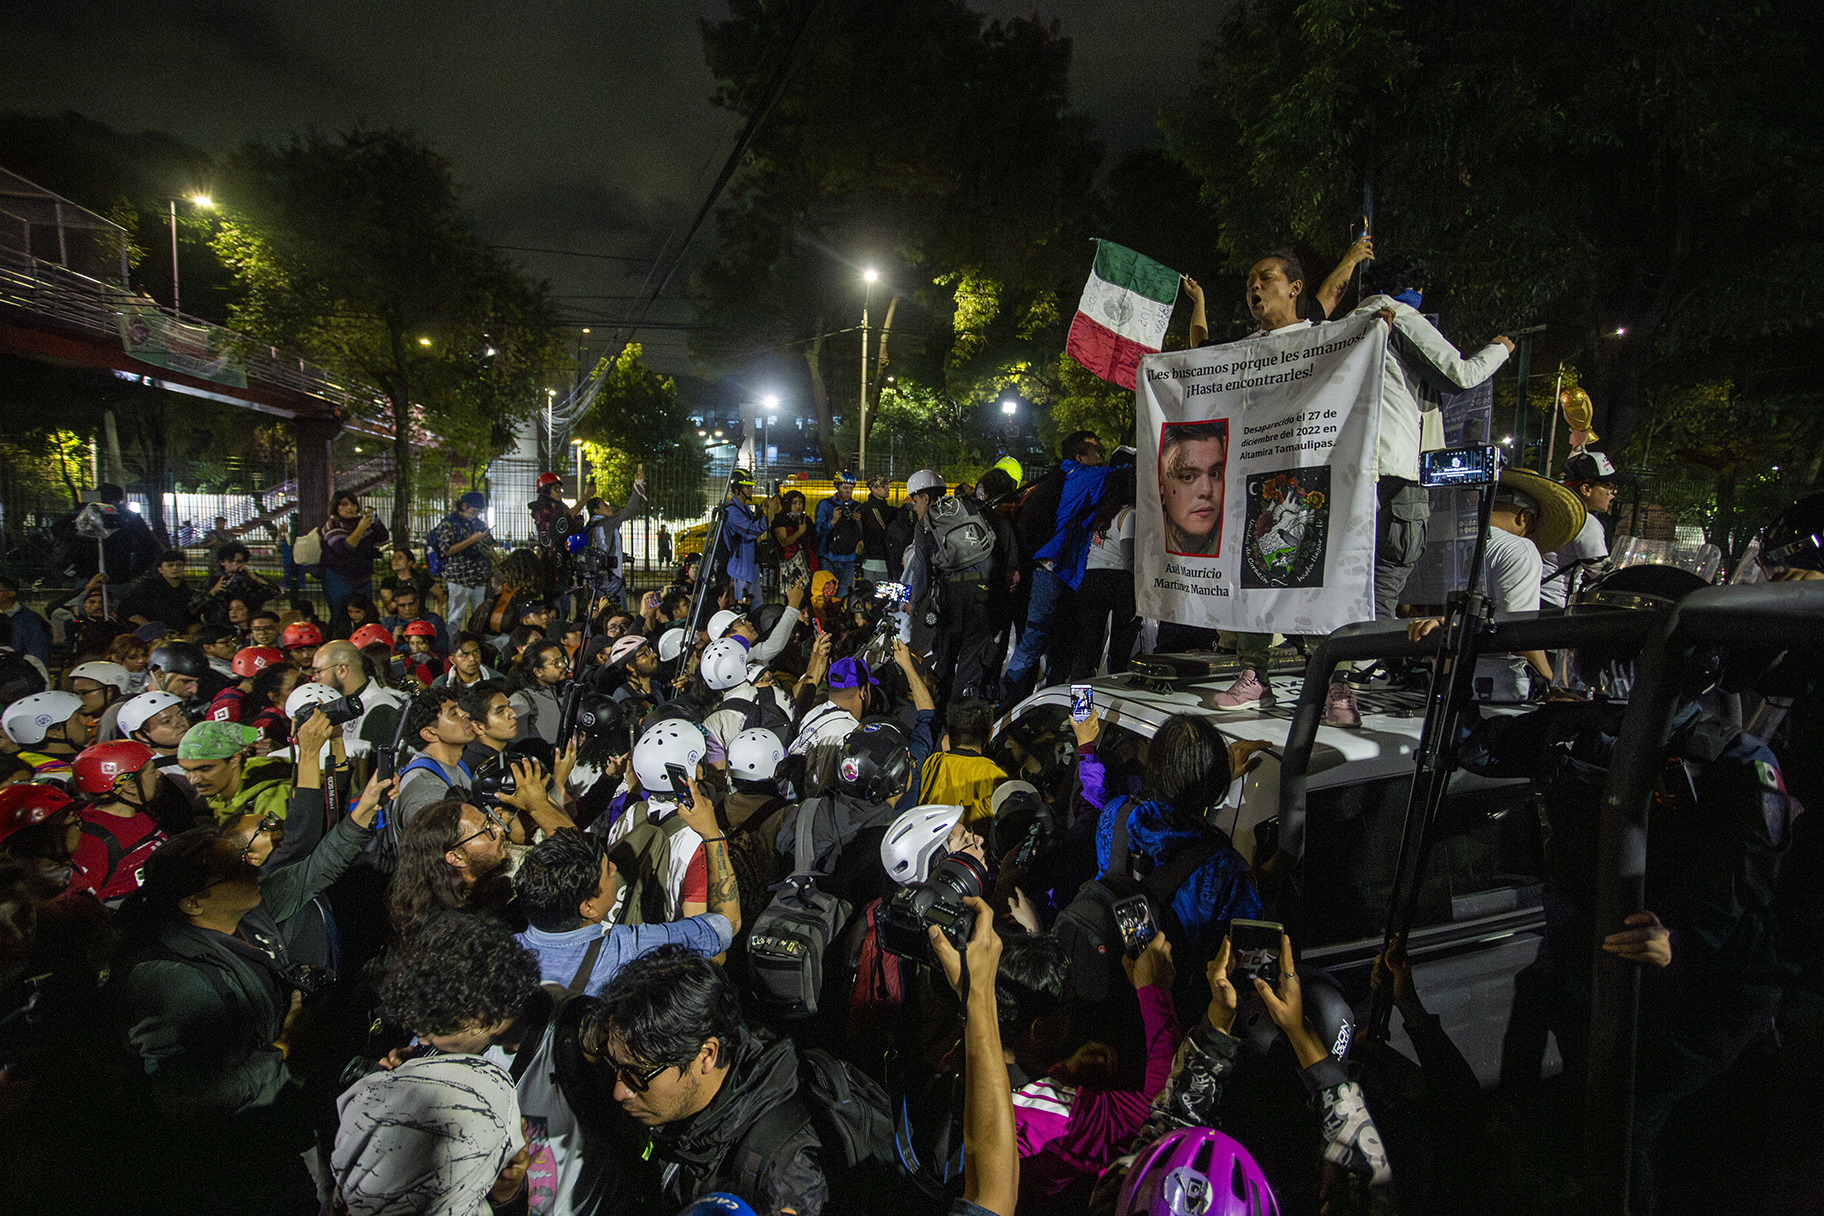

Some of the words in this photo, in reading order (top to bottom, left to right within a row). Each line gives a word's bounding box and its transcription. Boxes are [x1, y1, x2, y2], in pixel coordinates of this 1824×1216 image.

[1147, 368, 1169, 382] ¡Les
[1172, 363, 1229, 379] buscamos
[1231, 355, 1278, 374] porque
[1281, 350, 1299, 363] les
[1302, 327, 1367, 359] amamos!
[1186, 383, 1223, 398] ¡Hasta
[1225, 363, 1314, 391] encontrarles!
[1243, 416, 1295, 435] Desaparecido
[1296, 412, 1305, 422] el
[1308, 411, 1320, 421] 27
[1323, 409, 1337, 419] de
[1241, 433, 1279, 447] diciembre
[1280, 428, 1294, 439] del
[1296, 425, 1321, 437] 2022
[1323, 425, 1337, 433] en
[1239, 448, 1273, 461] Altamira
[1275, 440, 1336, 454] Tamaulipas.
[1190, 584, 1229, 597] Mancha
